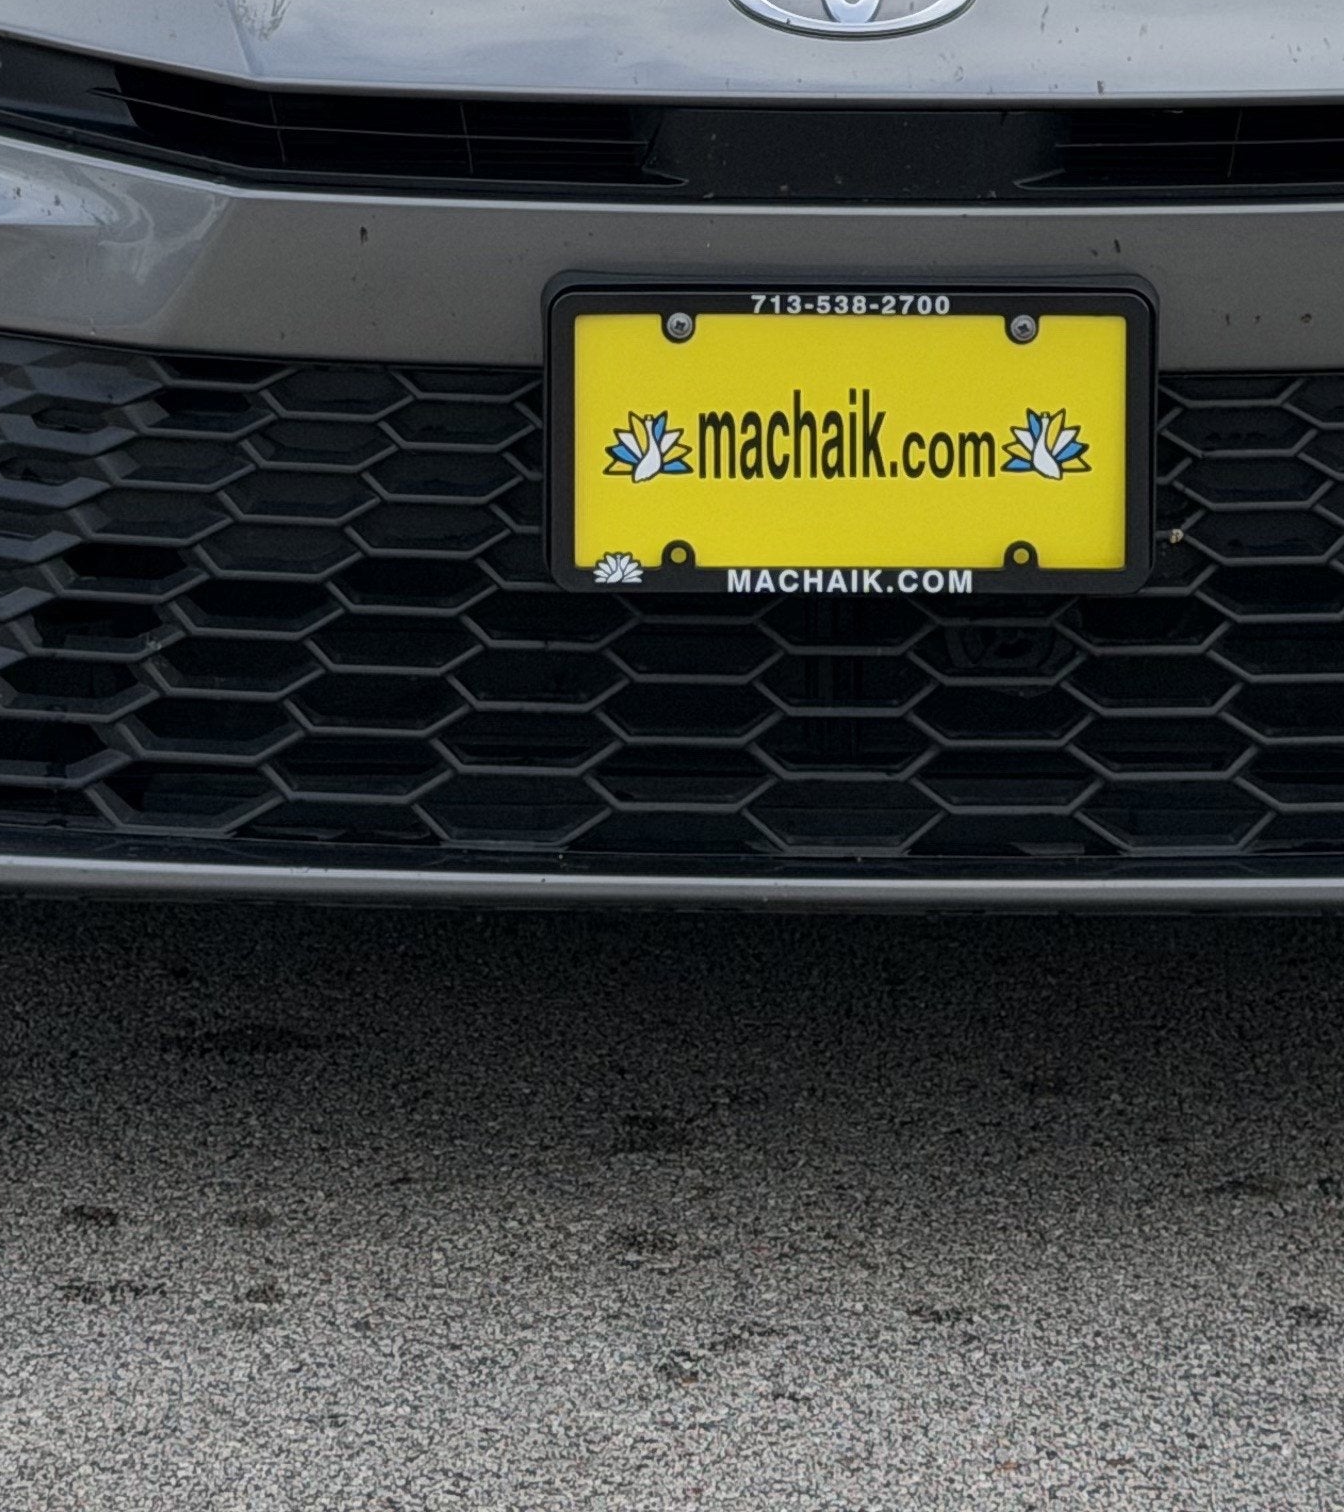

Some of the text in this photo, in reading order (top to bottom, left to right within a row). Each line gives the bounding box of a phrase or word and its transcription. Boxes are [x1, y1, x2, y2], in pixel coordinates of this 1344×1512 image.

[750, 294, 951, 315] 713-538-2700
[698, 387, 997, 480] machaik.com
[727, 569, 973, 594] MACHAIK.COM
